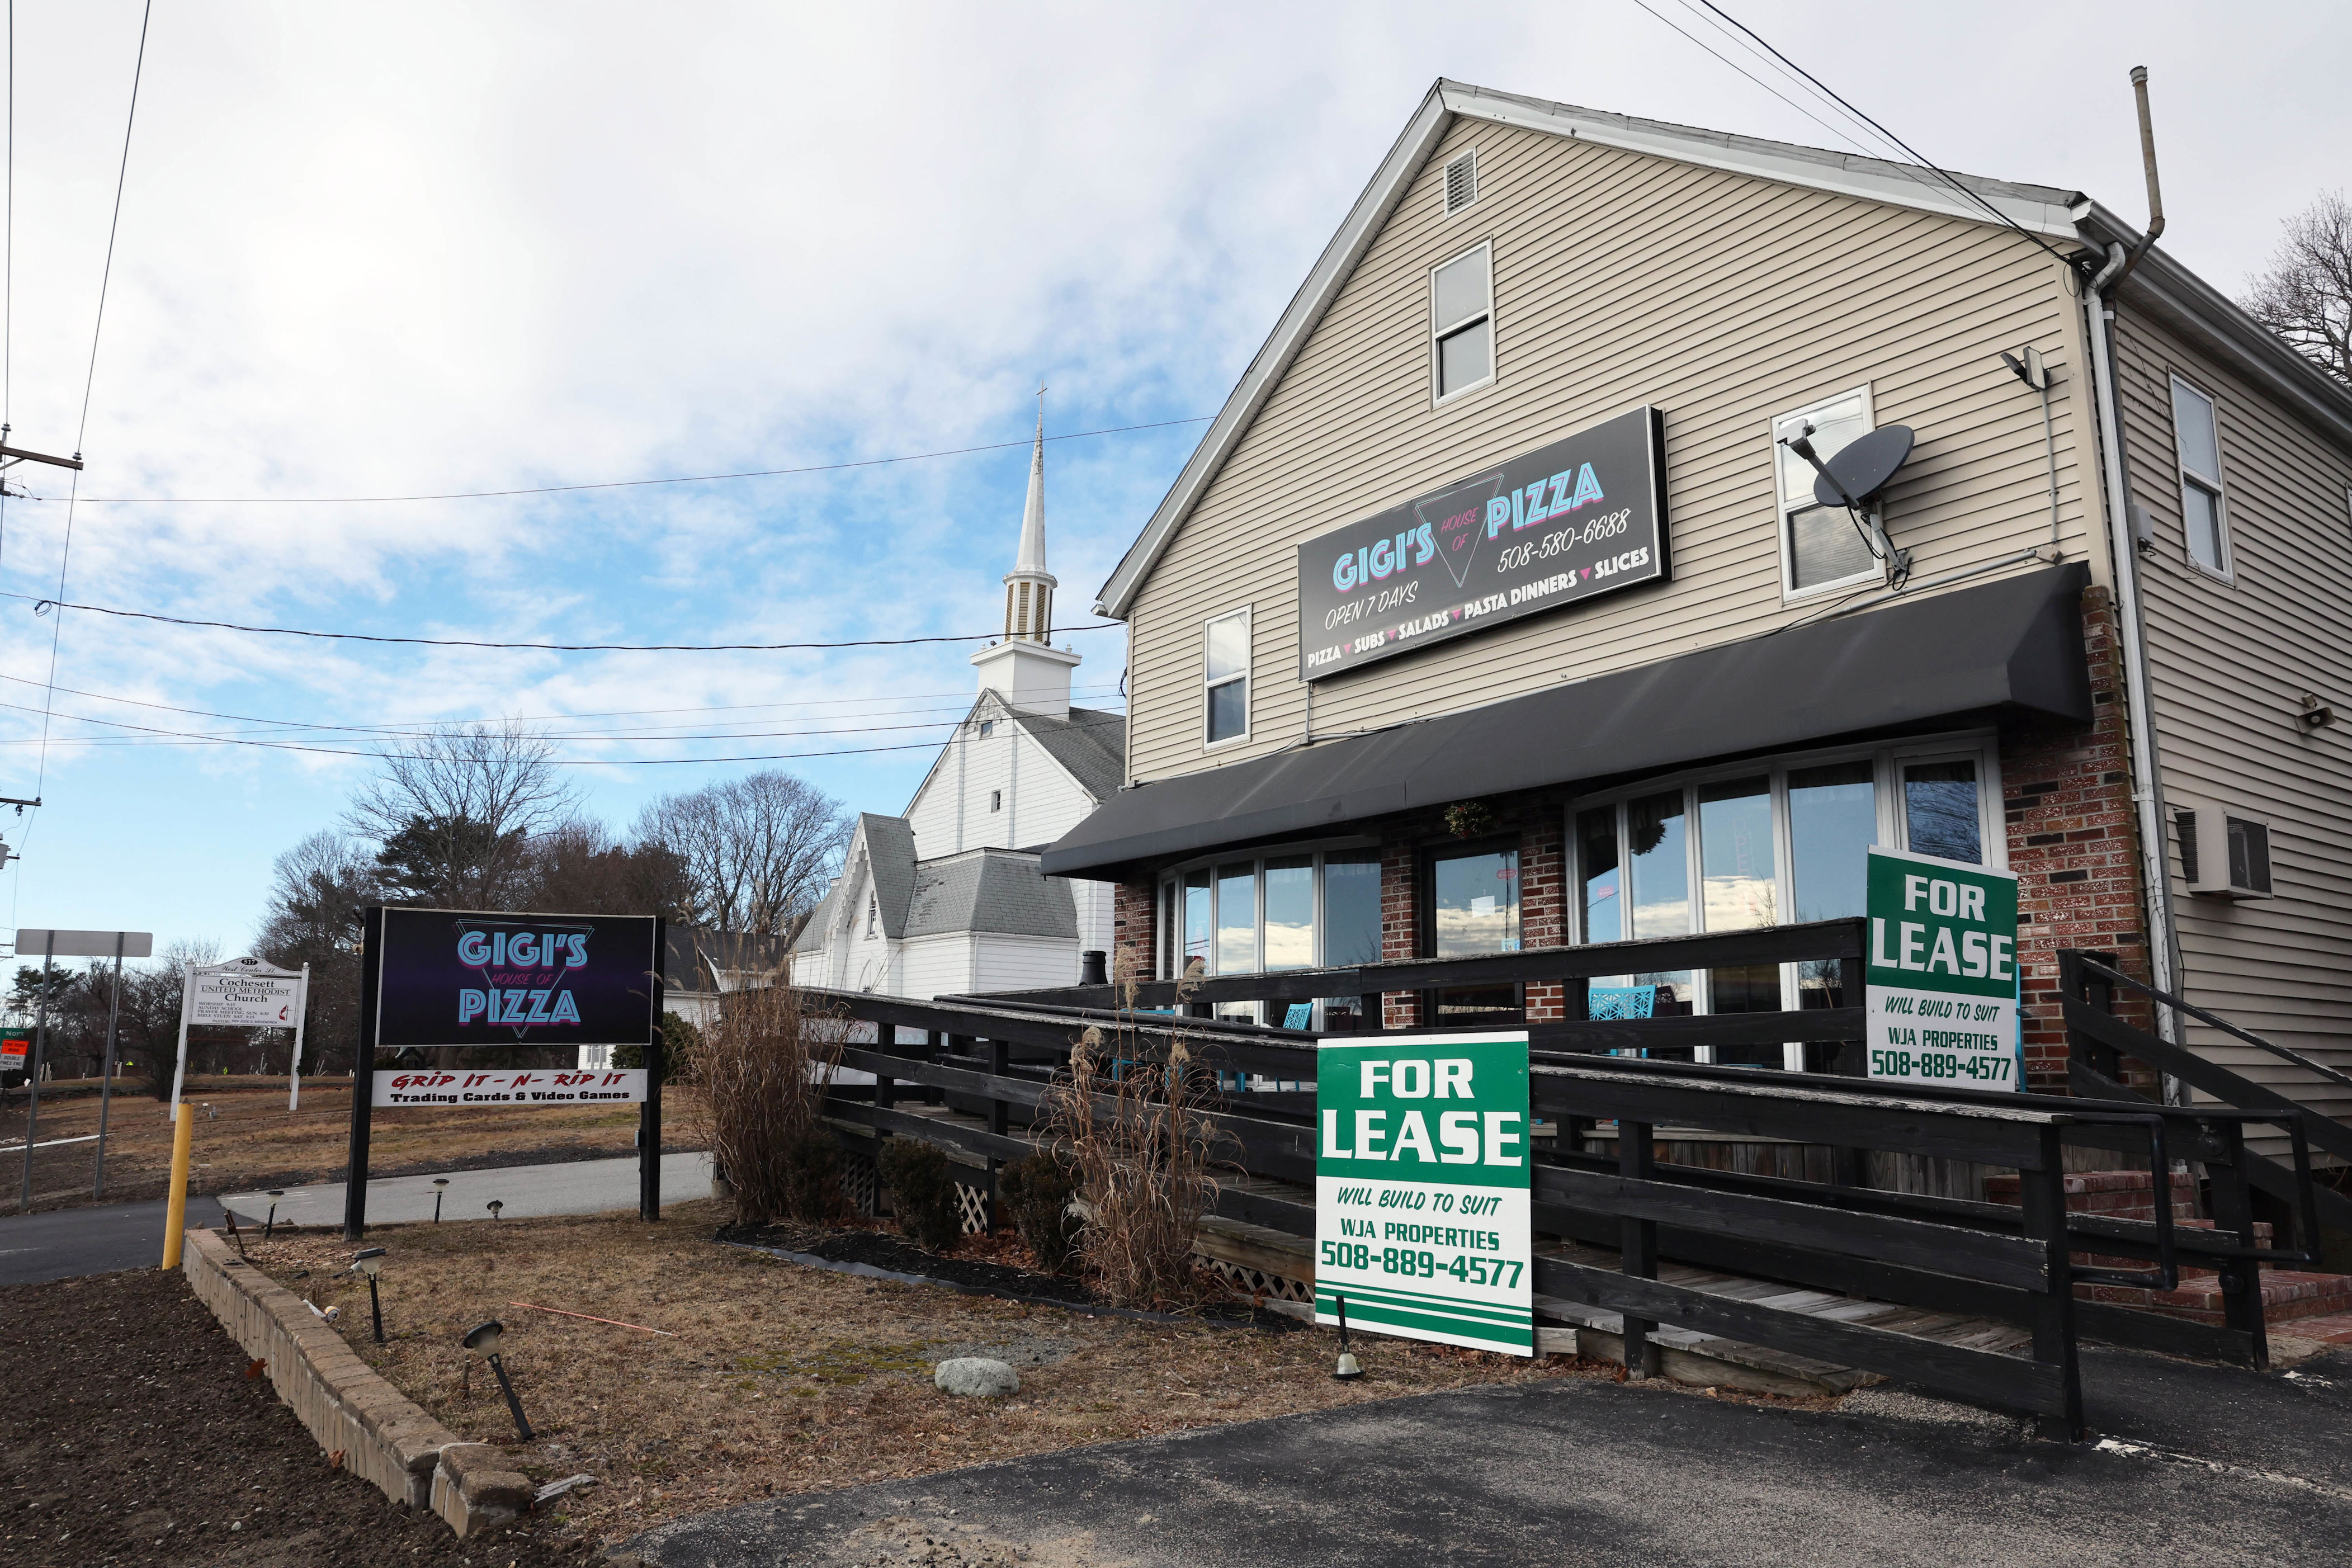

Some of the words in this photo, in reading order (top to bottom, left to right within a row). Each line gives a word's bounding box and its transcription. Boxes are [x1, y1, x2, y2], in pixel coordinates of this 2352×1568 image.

[1441, 506, 1479, 532] HOUSE
[1486, 461, 1605, 540] PIZZA
[1333, 522, 1435, 593] GIGI'S
[1452, 532, 1469, 551] OF
[1498, 508, 1631, 573] 508-580-6688
[1307, 646, 1342, 668] PIZZA
[1354, 630, 1385, 654] SUBS
[1399, 610, 1449, 640] SALADS
[1464, 597, 1508, 620] PASTA
[1510, 569, 1577, 605] DINNERS
[1594, 546, 1650, 580] SLICES
[1325, 599, 1364, 630] OPEN
[1366, 595, 1376, 615] 7
[1377, 580, 1418, 613] DAYS
[1904, 873, 1986, 922] FOR
[457, 931, 588, 969] GIGI'S
[1872, 917, 2013, 981] LEASE
[219, 979, 275, 988] Cochesett
[492, 973, 529, 985] HOUSE
[536, 974, 554, 985] OF
[225, 994, 267, 1003] Church
[459, 989, 580, 1026] PIZZA
[1885, 995, 1913, 1016] WILL
[1918, 999, 1952, 1019] BUILD
[1957, 1003, 1970, 1020] TO
[1974, 1004, 2000, 1022] SUIT
[1888, 1027, 1916, 1046] WJA
[1923, 1029, 1997, 1051] PROPERTIES
[1360, 1059, 1475, 1099] FOR
[1872, 1050, 2011, 1081] 508-889-4577
[390, 1093, 457, 1103] Trading
[463, 1092, 511, 1102] Cards
[515, 1092, 526, 1101] &
[531, 1092, 575, 1101] Video
[579, 1091, 630, 1099] Games
[1322, 1109, 1523, 1166] LEASE
[1337, 1186, 1372, 1206] WILL
[1378, 1189, 1426, 1211] BUILD
[1433, 1193, 1454, 1213] TO
[1460, 1195, 1503, 1217] SUIT
[1340, 1217, 1376, 1239] WJA
[1385, 1222, 1500, 1251] PROPERTIES
[1321, 1240, 1524, 1289] 508-889-4577
